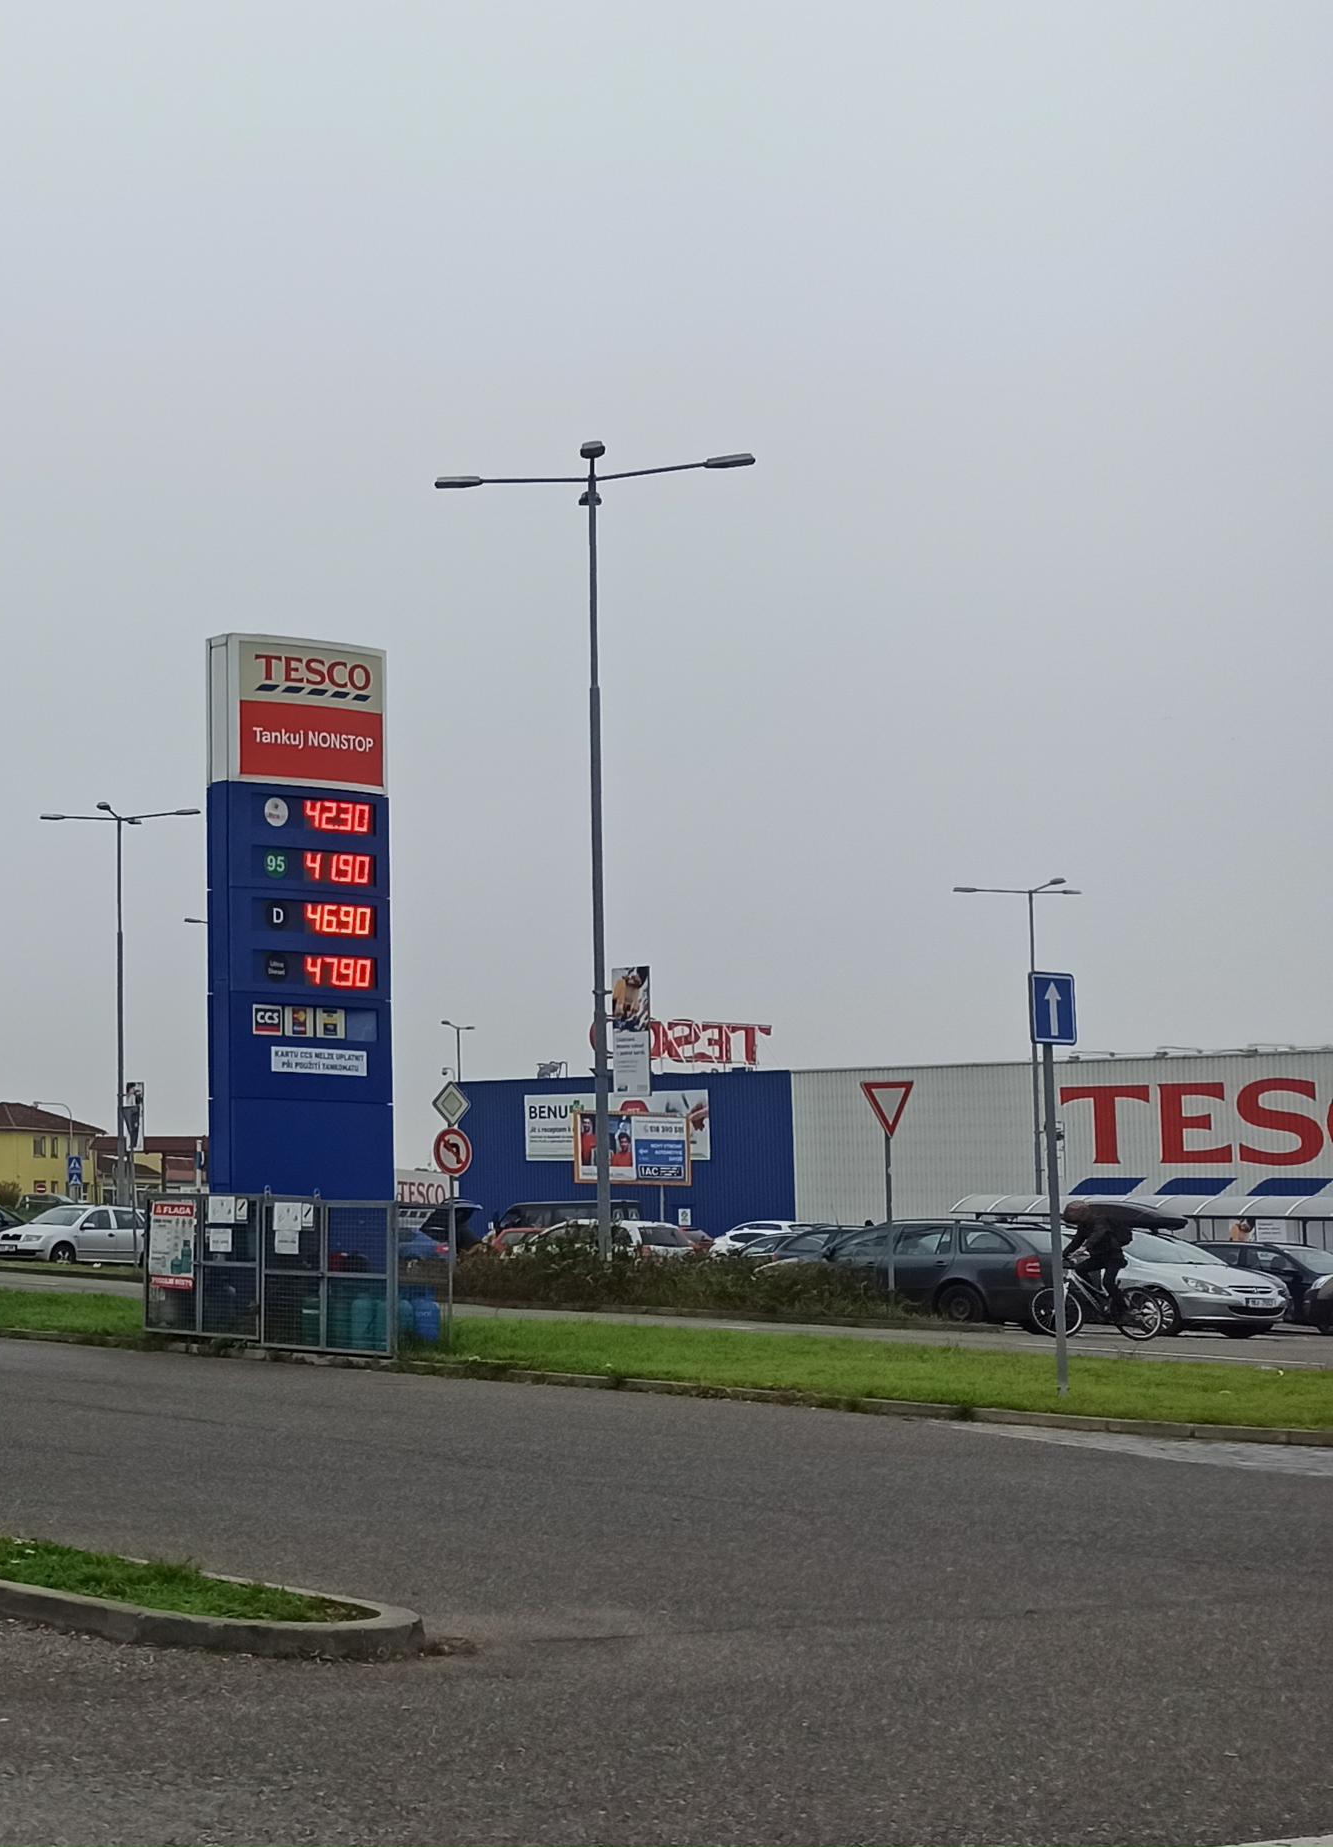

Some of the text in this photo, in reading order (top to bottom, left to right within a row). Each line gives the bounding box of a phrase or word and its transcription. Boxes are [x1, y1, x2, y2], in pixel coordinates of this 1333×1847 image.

[255, 654, 371, 691] TESCO
[253, 727, 374, 751] Tankuj NONSTOP
[267, 855, 285, 872] 95
[273, 908, 284, 923] D
[257, 1011, 279, 1024] CCS
[274, 1050, 299, 1058] KARTU
[300, 1051, 313, 1059] CCS
[529, 1105, 568, 1119] BENU
[1060, 1078, 1333, 1166] TES
[641, 1166, 659, 1176] IAC
[398, 1181, 446, 1205] TESCO
[163, 1206, 192, 1215] FLAGA
